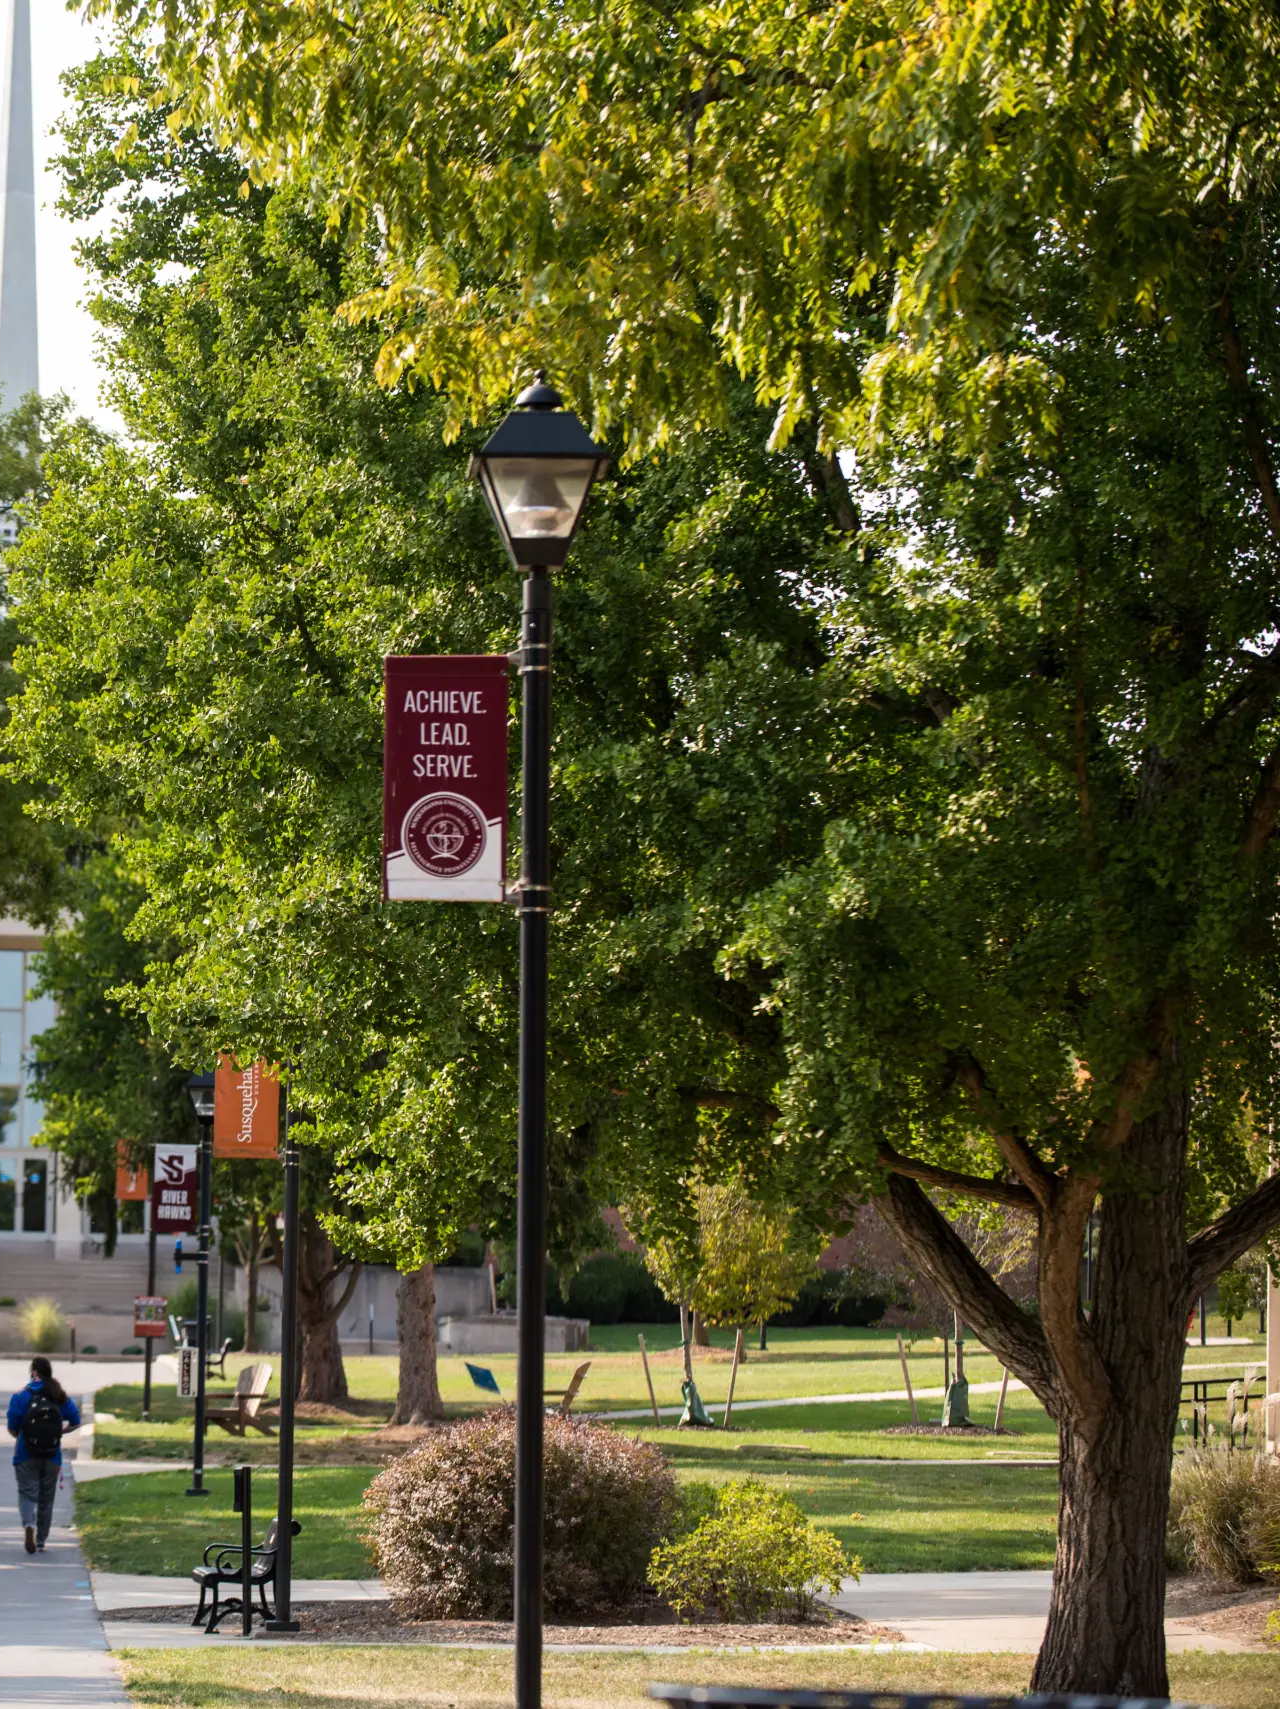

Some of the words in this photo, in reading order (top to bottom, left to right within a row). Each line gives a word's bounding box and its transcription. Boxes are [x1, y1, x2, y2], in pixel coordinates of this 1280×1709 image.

[403, 690, 488, 714] ACHIEVE.
[420, 722, 471, 746] LEAD.
[412, 754, 478, 778] SERVE.
[161, 1189, 188, 1204] RIVER
[157, 1205, 192, 1220] HAWKS
